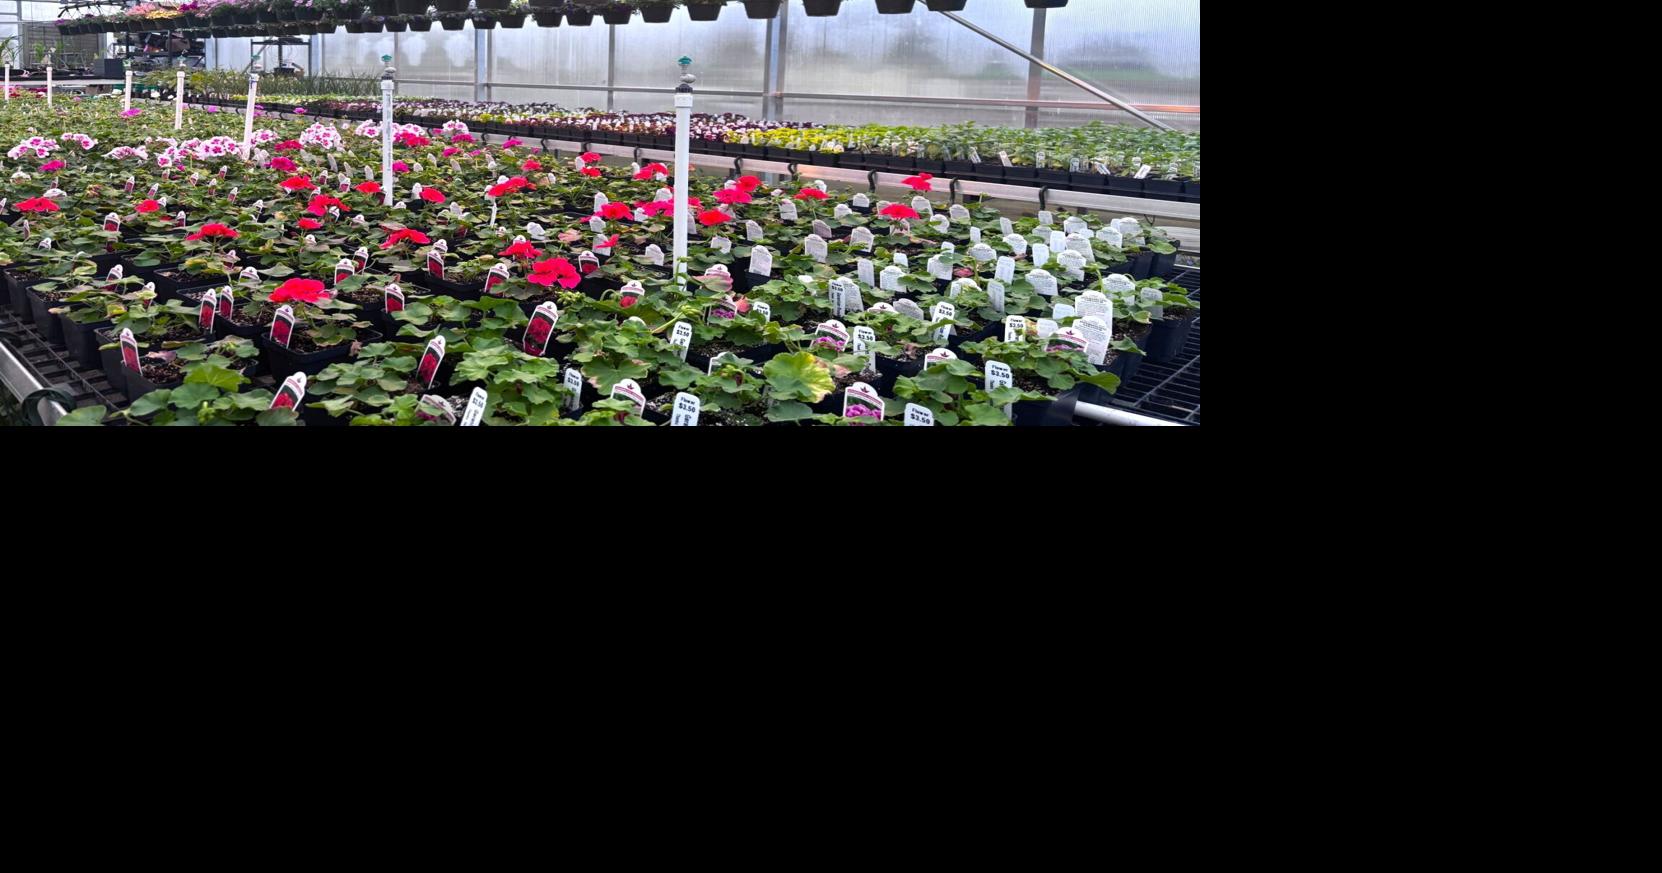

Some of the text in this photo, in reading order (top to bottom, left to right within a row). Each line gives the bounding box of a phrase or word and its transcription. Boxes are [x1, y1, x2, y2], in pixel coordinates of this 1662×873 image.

[990, 369, 1010, 379] $3.50
[680, 396, 696, 405] Flower
[678, 402, 696, 413] $3.50
[911, 407, 929, 416] Flower
[910, 413, 931, 425] $3.50
